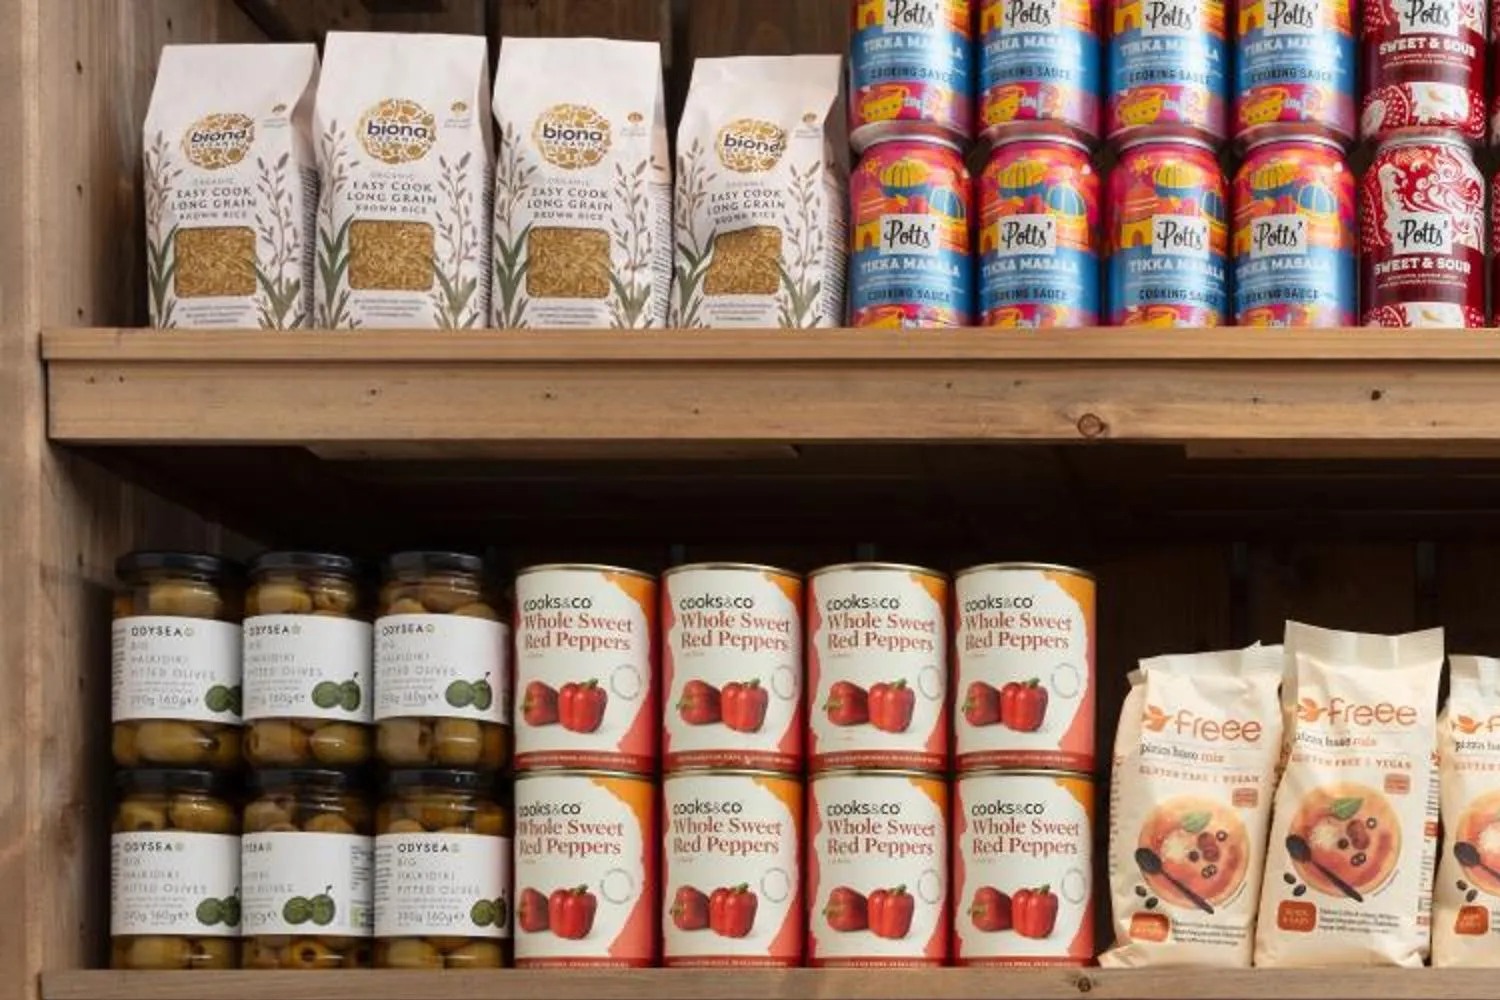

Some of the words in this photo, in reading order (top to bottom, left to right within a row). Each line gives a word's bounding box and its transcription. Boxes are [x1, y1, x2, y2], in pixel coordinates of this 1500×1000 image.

[191, 129, 247, 142] biona
[367, 121, 427, 138] biona
[543, 124, 602, 141] biona
[177, 189, 208, 198] EASY
[212, 187, 251, 197] COOK
[532, 188, 564, 197] EASY
[568, 188, 608, 199] COOK
[171, 199, 207, 210] LONG
[213, 199, 257, 208] GRAIN
[527, 200, 563, 210] LONG
[568, 200, 612, 211] GRAIN
[1375, 258, 1420, 274] SWEET
[1422, 257, 1434, 269] &
[1437, 258, 1471, 274] SOUR
[131, 626, 183, 637] ODYSEA
[524, 613, 573, 630] Whole
[578, 613, 633, 634] Sweet
[965, 613, 1015, 631] Whole
[1019, 613, 1071, 633] Sweet
[525, 631, 552, 649] Red
[556, 632, 631, 653] Peppers
[965, 631, 993, 650] Red
[999, 632, 1069, 652] Peppers
[1326, 697, 1417, 727] freee
[1174, 709, 1262, 742] freee
[827, 818, 882, 836] Whole
[887, 818, 935, 838] Sweet
[972, 818, 1027, 836] Whole
[1032, 818, 1079, 838] Sweet
[124, 842, 173, 853] ODYSEA
[397, 843, 449, 854] ODYSEA
[828, 836, 859, 855] Red
[864, 837, 934, 858] Peppers
[972, 836, 1003, 855] Red
[1008, 837, 1078, 858] Peppers
